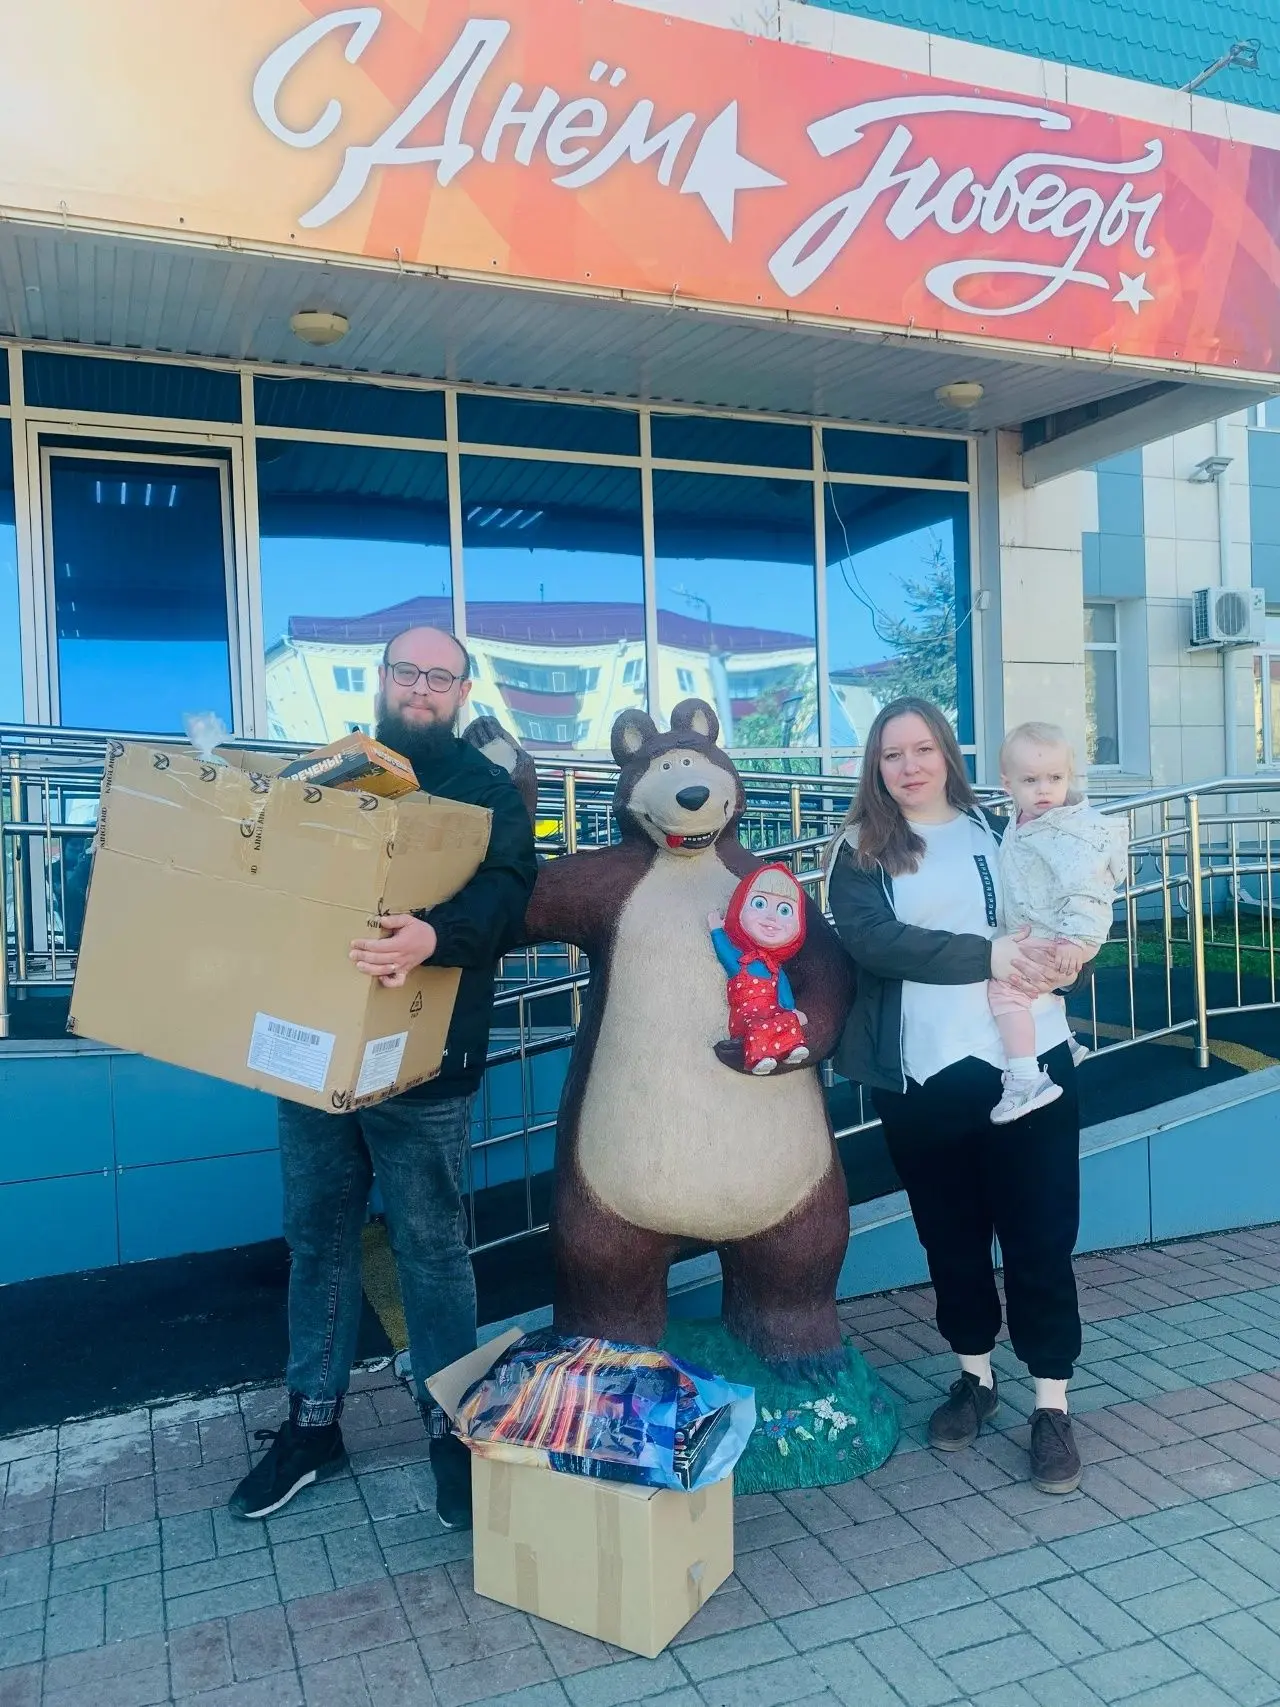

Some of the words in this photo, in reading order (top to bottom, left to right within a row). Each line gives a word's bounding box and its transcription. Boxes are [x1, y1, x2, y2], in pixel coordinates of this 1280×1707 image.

[251, 8, 382, 149] С
[299, 19, 697, 229] Днём
[767, 95, 1164, 317] Победы
[253, 807, 265, 851] KINGLAN
[286, 753, 343, 782] РЕЧЕНЫ!
